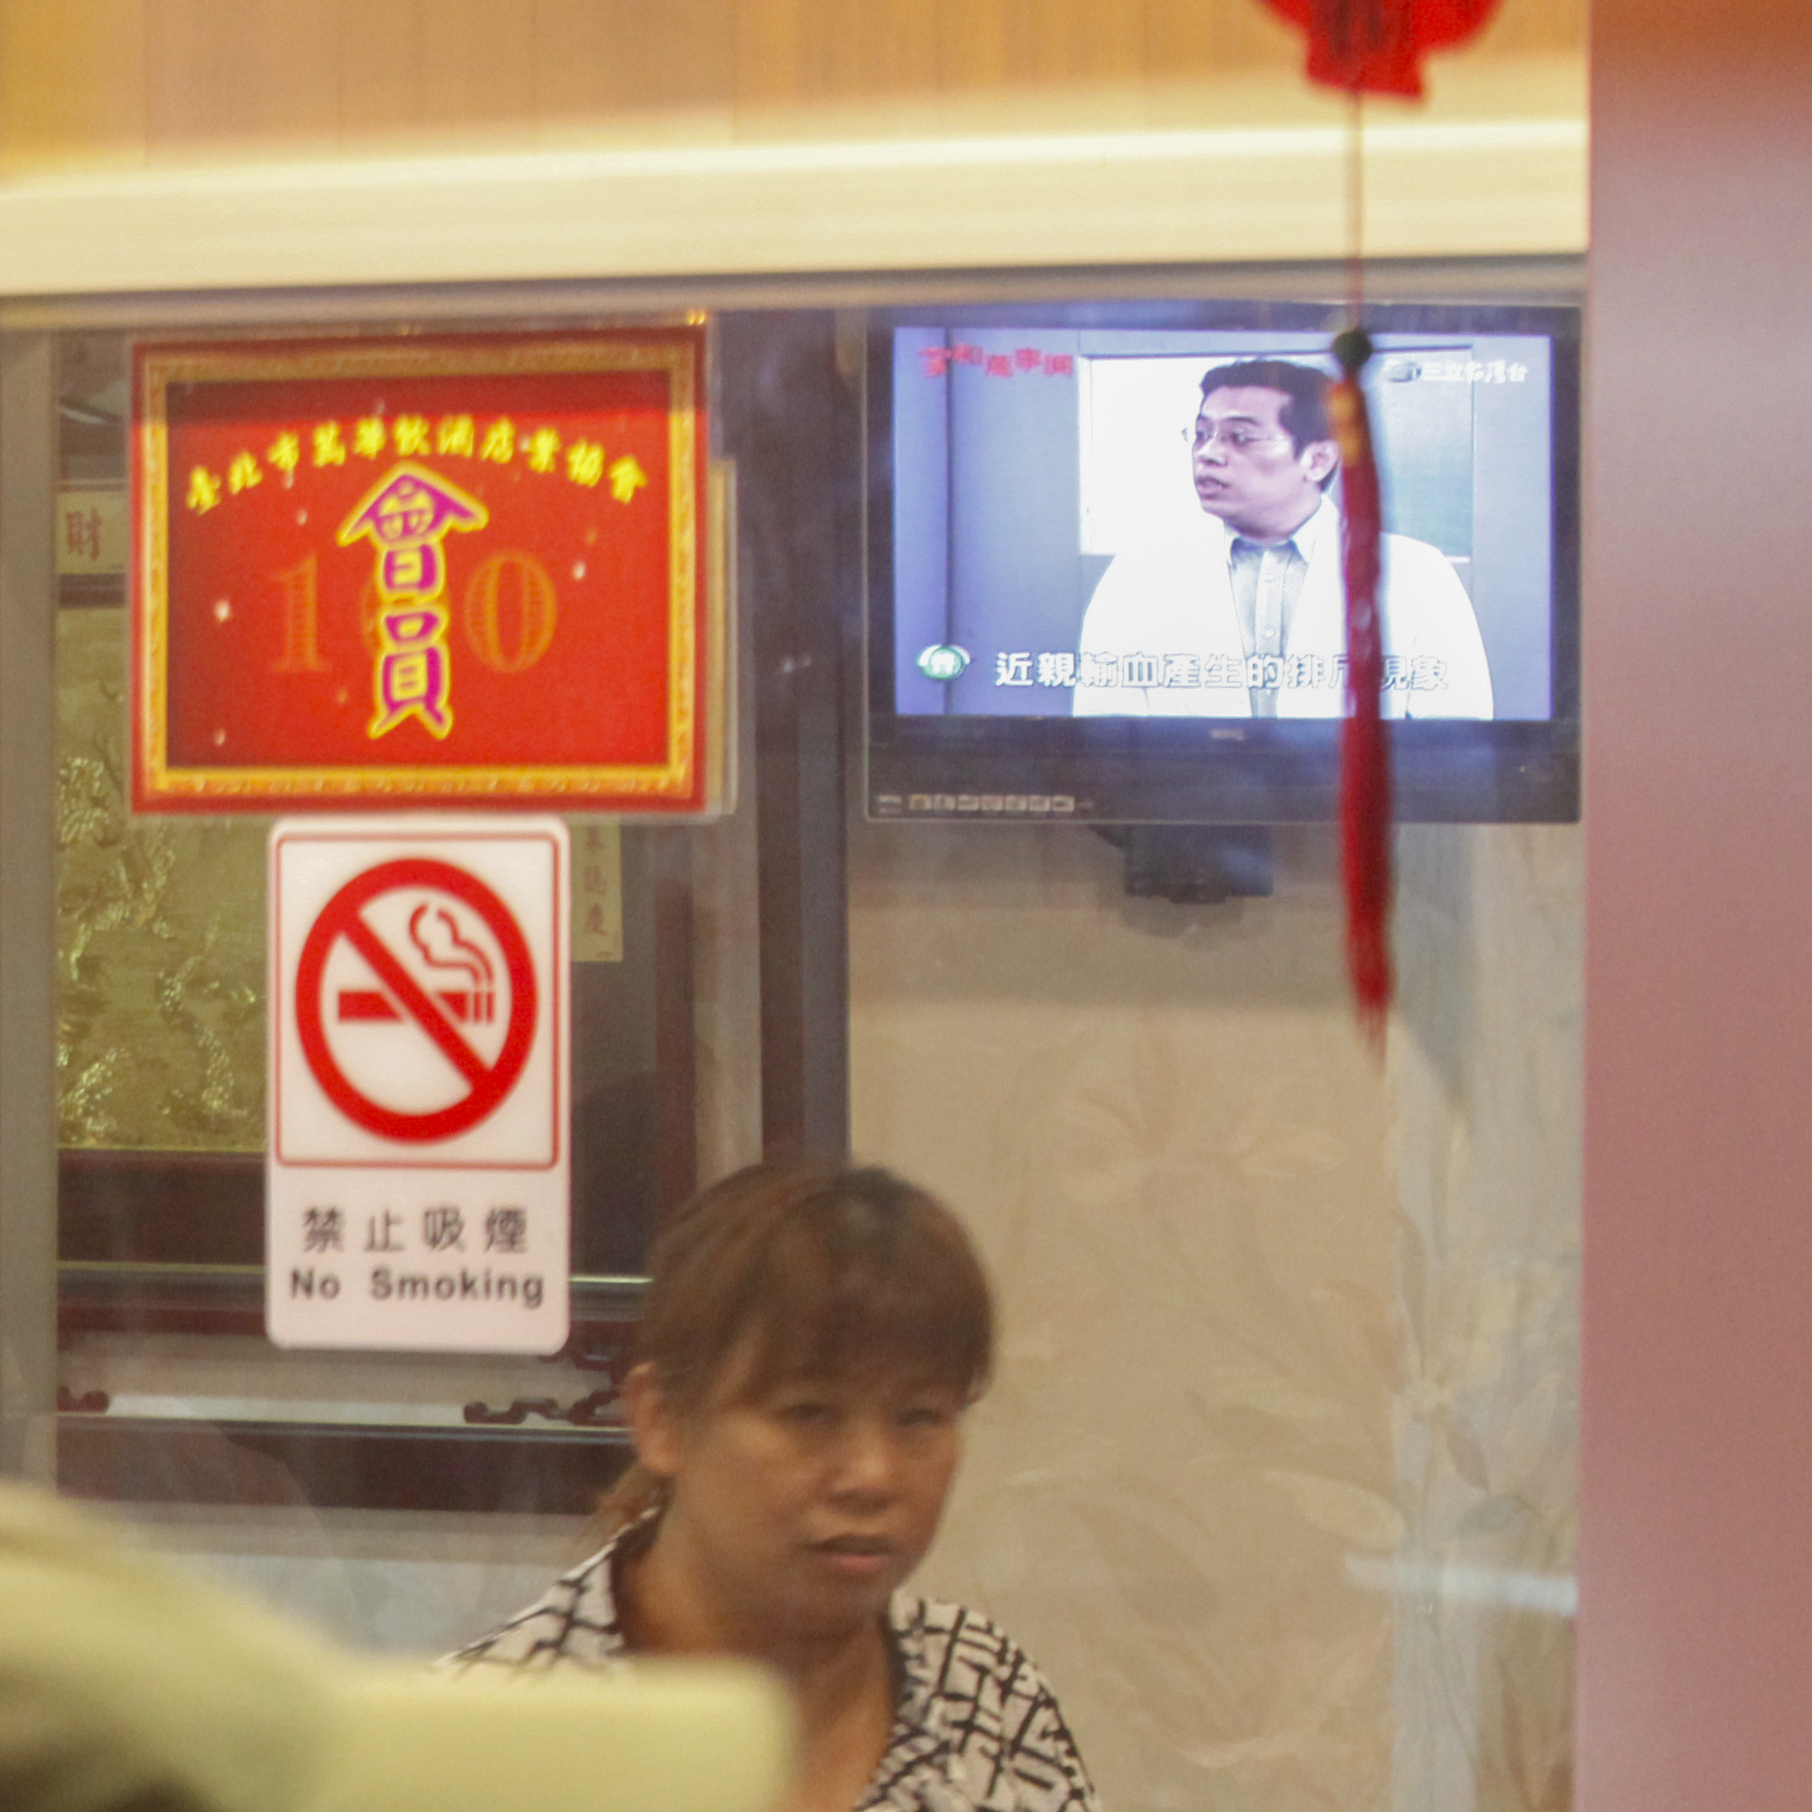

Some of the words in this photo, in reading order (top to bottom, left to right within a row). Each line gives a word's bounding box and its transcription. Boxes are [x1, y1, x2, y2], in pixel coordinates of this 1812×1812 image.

[334, 460, 490, 741] 會員
[302, 1206, 528, 1253] 禁止吸煙
[290, 1268, 342, 1300] No
[369, 1265, 544, 1311] Smoking
